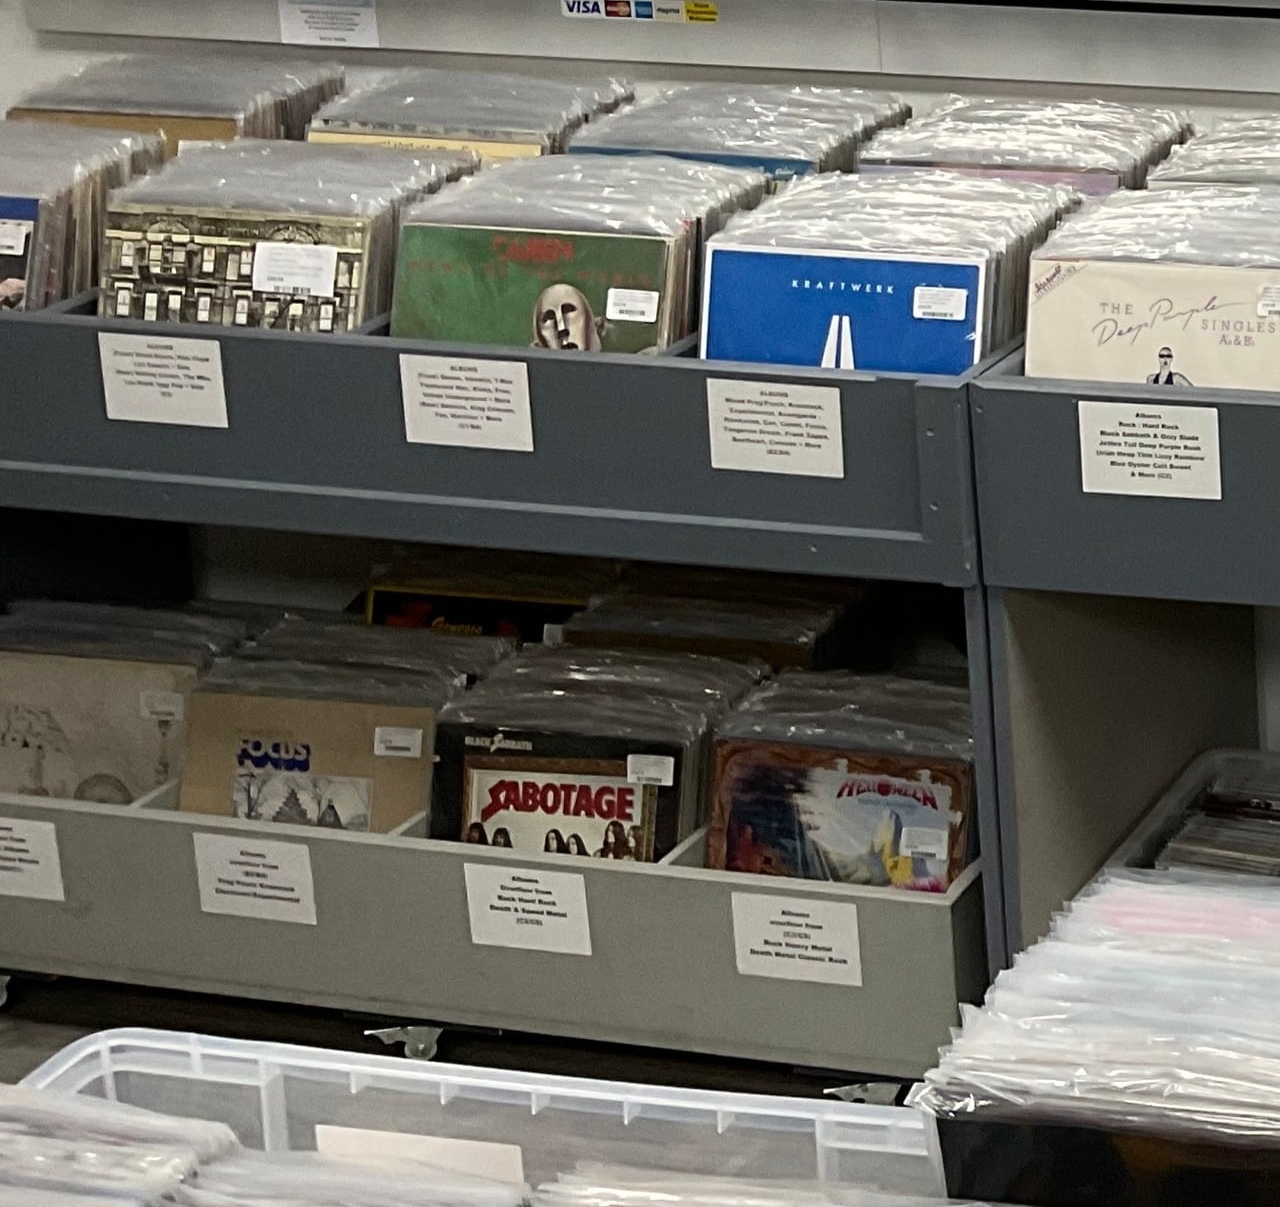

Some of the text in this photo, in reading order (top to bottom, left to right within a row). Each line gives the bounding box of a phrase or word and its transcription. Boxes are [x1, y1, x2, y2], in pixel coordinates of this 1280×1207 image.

[566, 0, 601, 14] VISA
[791, 279, 895, 294] KRAFTWERK
[1100, 302, 1134, 315] THE
[1200, 319, 1277, 334] SINGLES
[238, 739, 311, 773] FOCUS
[480, 779, 635, 822] SABOTAGE
